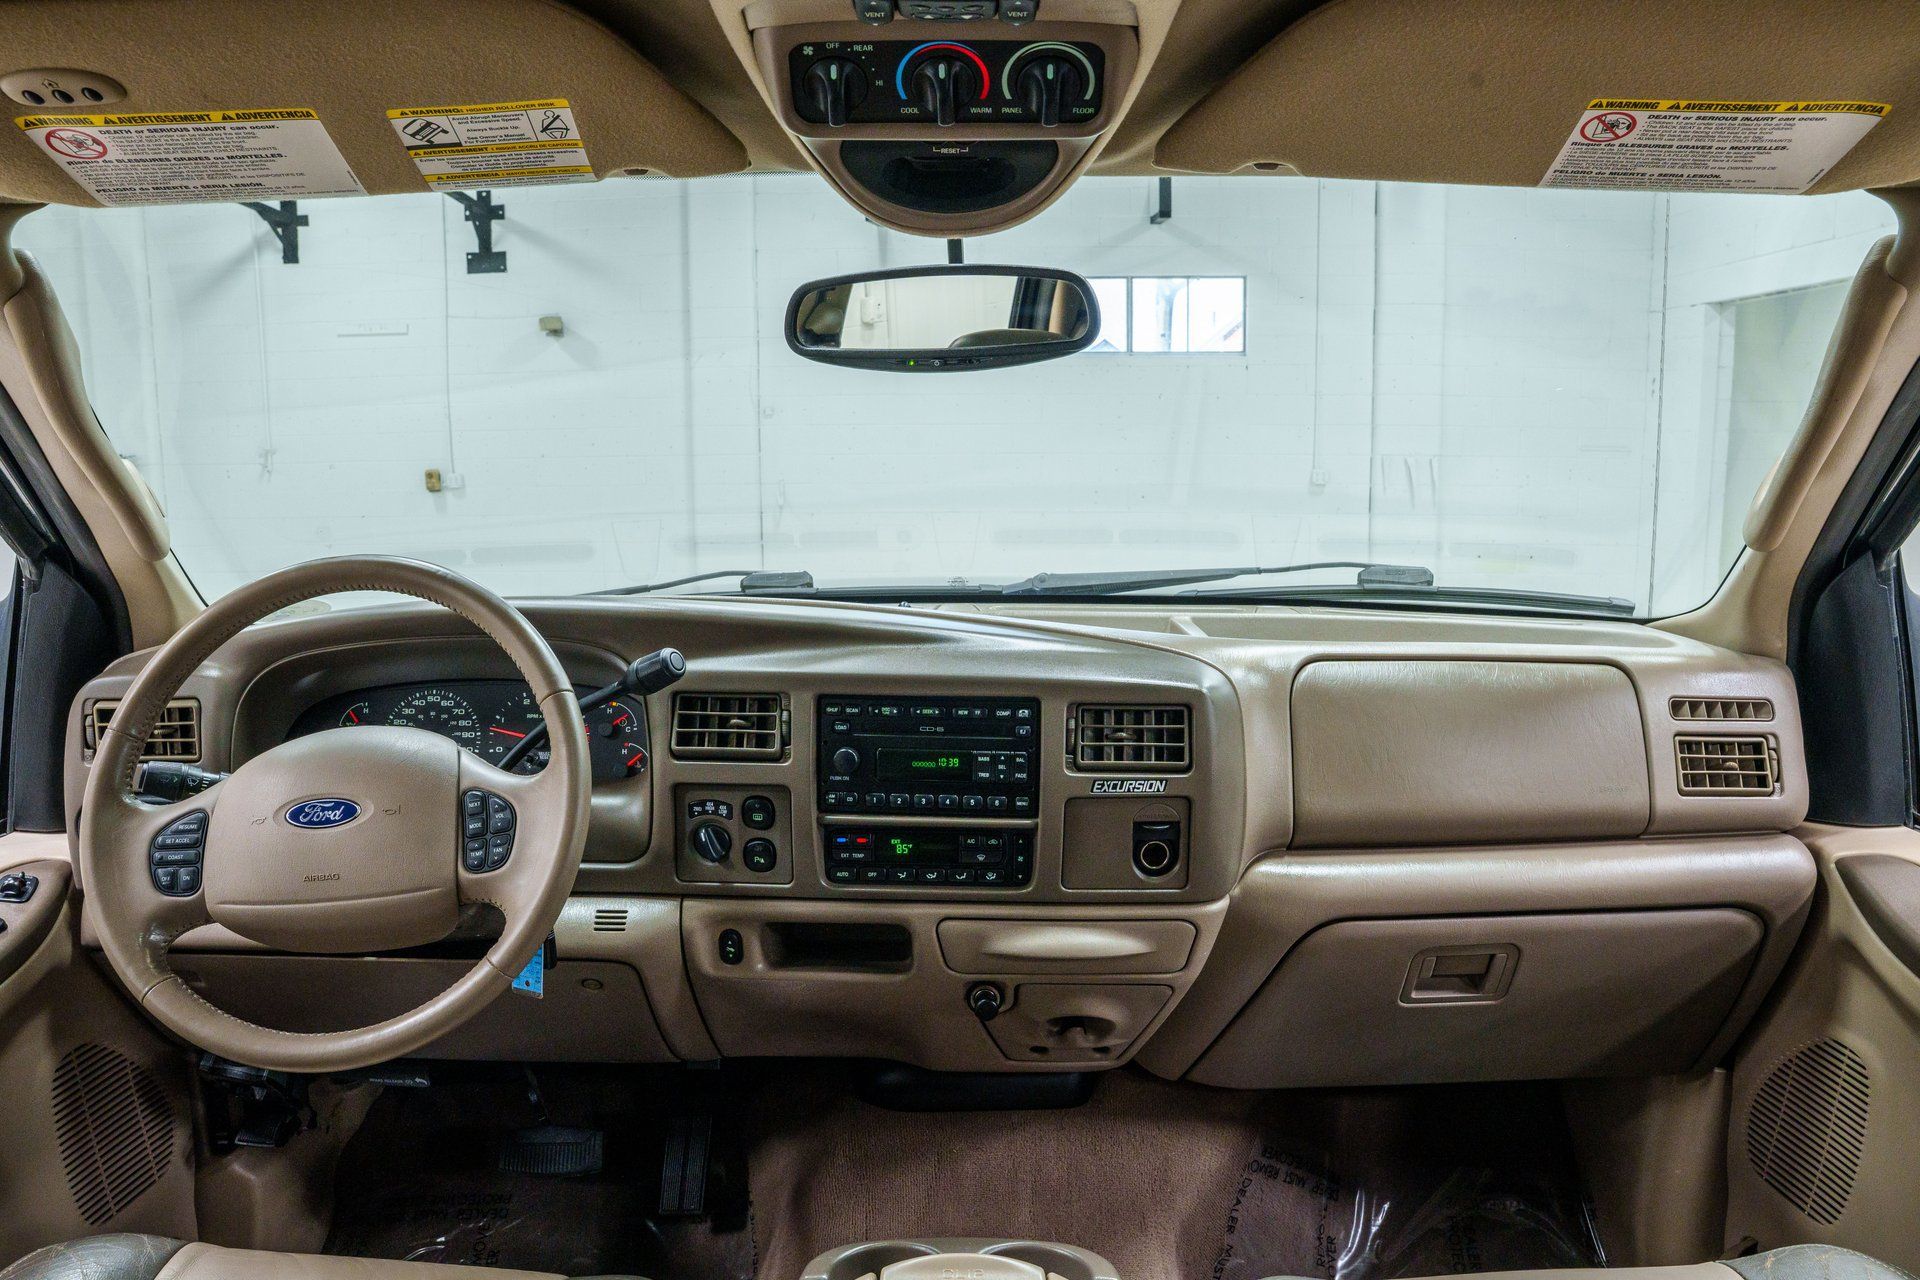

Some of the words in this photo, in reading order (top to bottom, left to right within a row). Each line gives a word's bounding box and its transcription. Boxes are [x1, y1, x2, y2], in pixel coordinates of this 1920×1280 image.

[853, 44, 873, 52] REAR
[1604, 101, 1660, 110] WARNING
[1681, 102, 1781, 111] AVERTISSEMENT
[1800, 103, 1885, 114] ADVERTENCIA
[117, 113, 212, 124] AVERTISSEMENT
[235, 110, 315, 121] ADVERTENCIA
[33, 117, 94, 126] WARNING
[1092, 780, 1166, 793] EXCURSION
[300, 802, 345, 823] Ford
[302, 873, 340, 882] AIRBAG
[1248, 1160, 1280, 1179] REMO
[1226, 1177, 1253, 1235] DEALER
[1327, 1235, 1338, 1280] OVER
